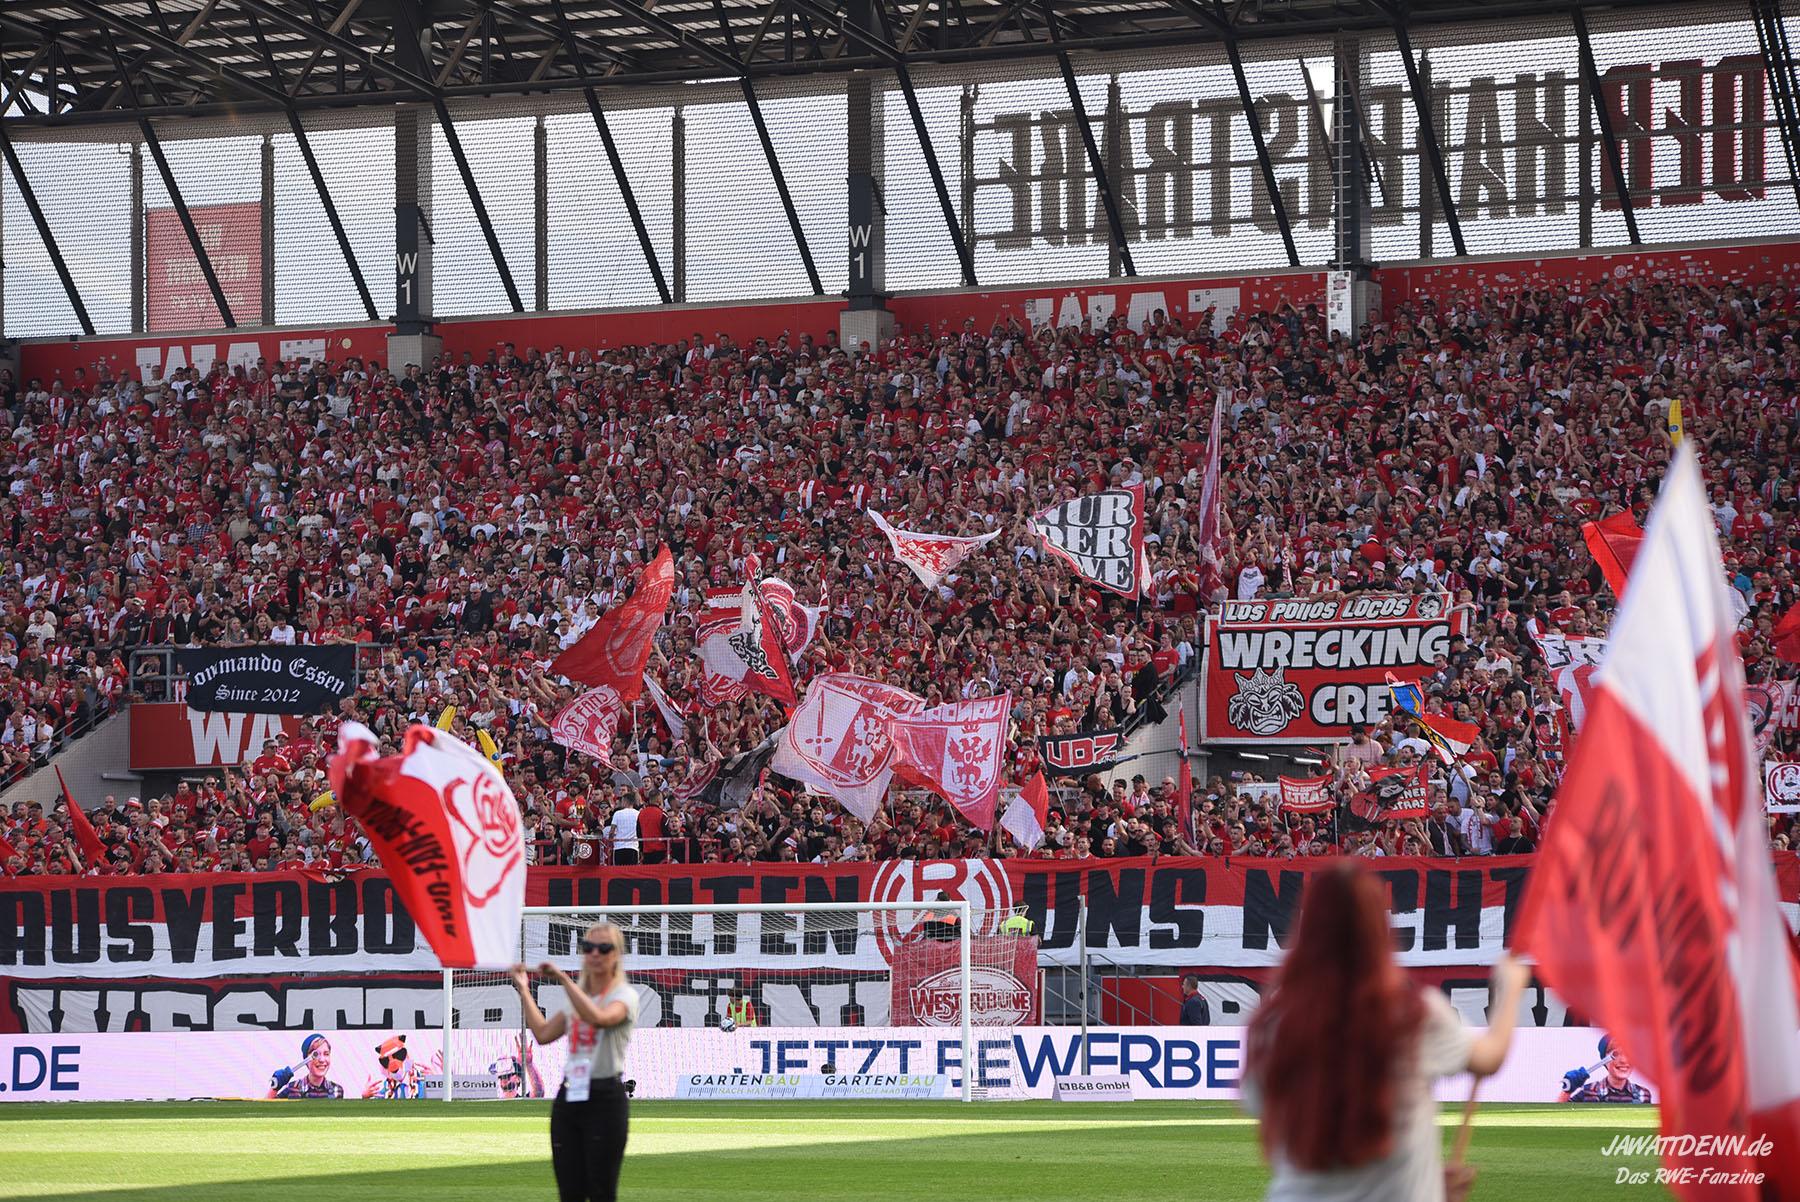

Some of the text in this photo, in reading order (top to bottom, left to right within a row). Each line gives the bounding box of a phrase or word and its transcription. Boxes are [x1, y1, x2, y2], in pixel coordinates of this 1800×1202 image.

[849, 224, 872, 248] W
[396, 252, 418, 275] W
[854, 252, 864, 279] 1
[401, 279, 411, 305] 1
[1225, 602, 1269, 623] LOS
[1341, 596, 1412, 620] LOCOS
[1219, 623, 1451, 669] WRECKING
[288, 657, 346, 695] Essen
[214, 684, 301, 703] Since 2012
[1311, 683, 1391, 726] CRE
[187, 705, 305, 766] WA
[0, 867, 1528, 965] AUSVERBO HALTEN UNS NCHT
[910, 987, 1031, 1019] WESTRIBÜNE
[733, 1040, 921, 1075] JETZT
[937, 1033, 1241, 1090] BEWERBE
[437, 1080, 497, 1088] BB GmbH
[691, 1074, 801, 1086] GARTENBAU
[824, 1074, 937, 1086] GARTENBAU
[1071, 1081, 1130, 1090] B&B GmbH
